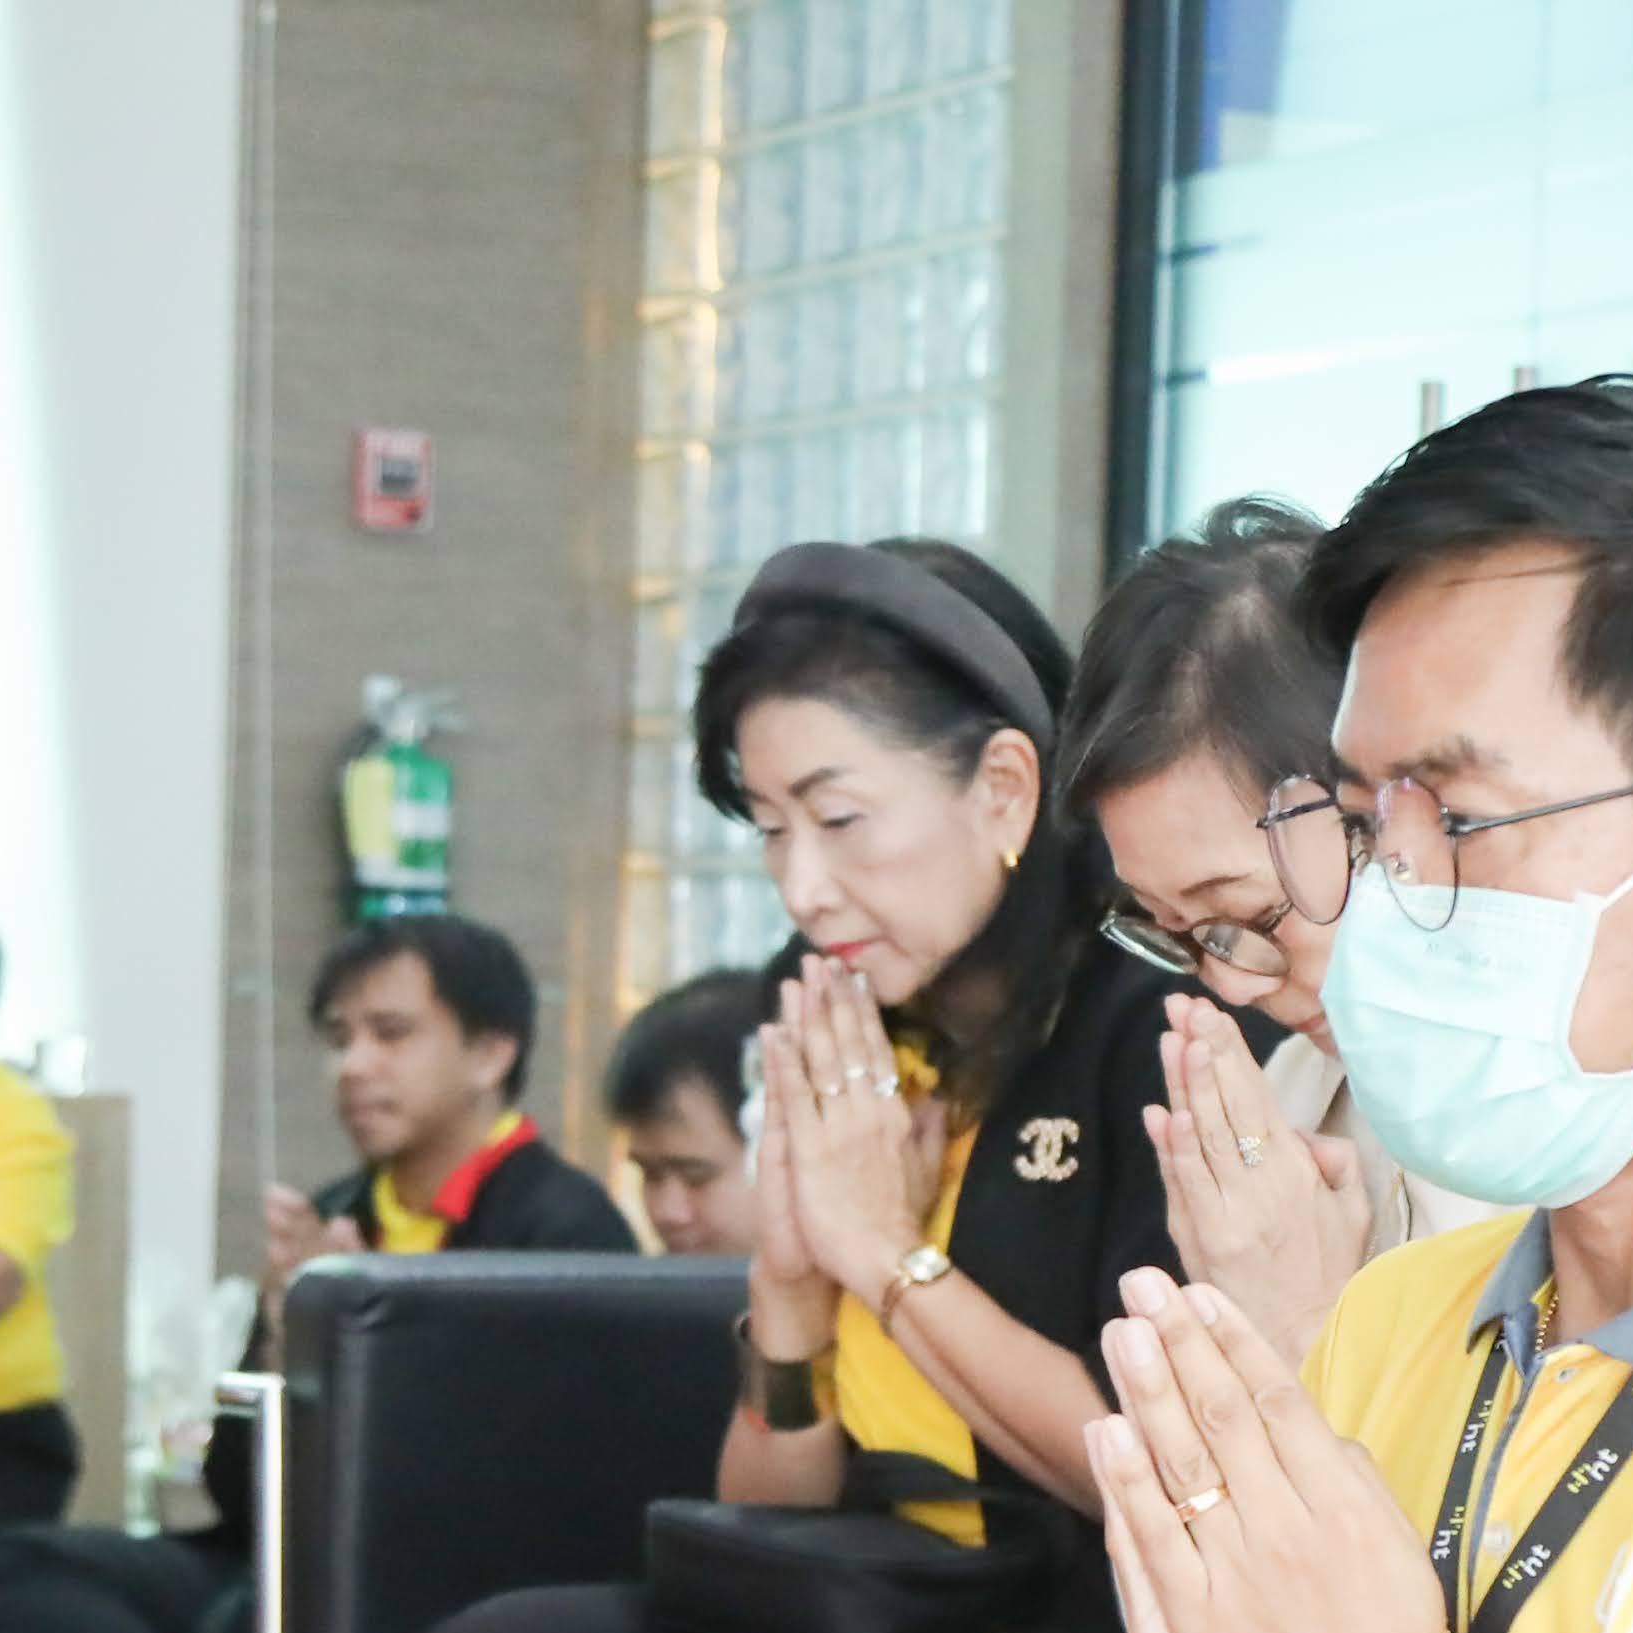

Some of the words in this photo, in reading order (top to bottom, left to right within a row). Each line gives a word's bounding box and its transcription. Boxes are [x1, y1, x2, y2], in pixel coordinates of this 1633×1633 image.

[1589, 1448, 1619, 1481] nt
[1433, 1529, 1451, 1560] nt
[1524, 1544, 1552, 1577] nt
